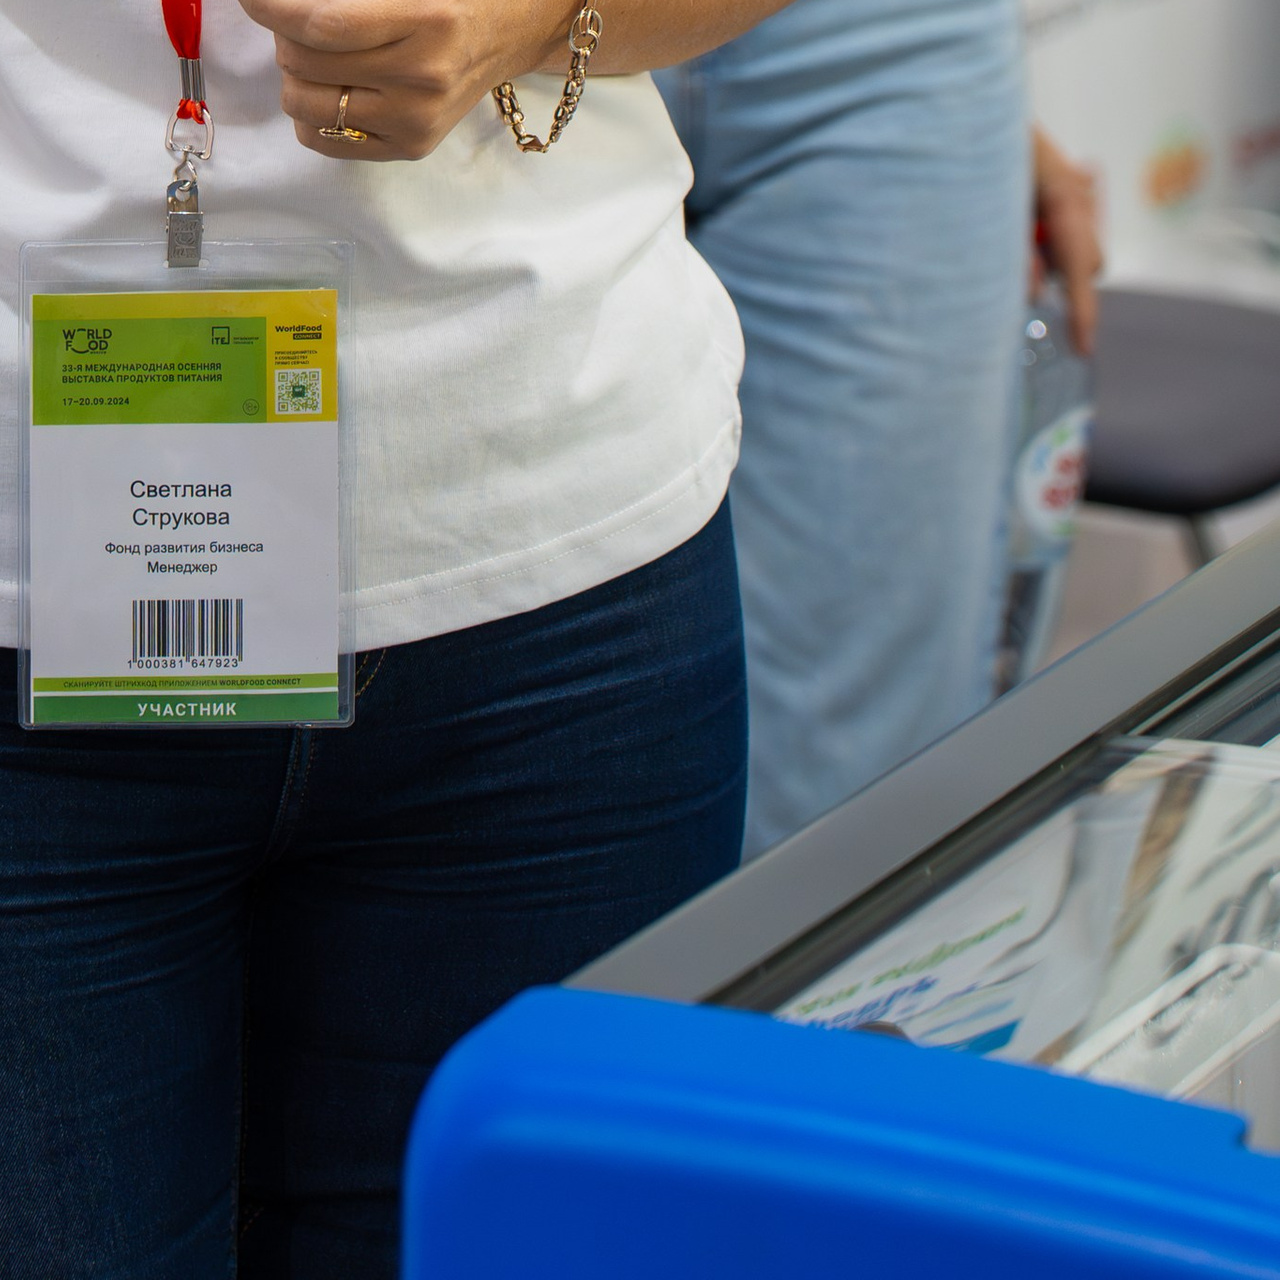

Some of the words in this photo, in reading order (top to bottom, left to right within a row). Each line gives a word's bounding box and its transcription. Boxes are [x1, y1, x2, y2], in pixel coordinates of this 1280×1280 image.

[275, 324, 322, 332] WorldFood
[62, 364, 83, 372] 33-Я
[85, 363, 175, 373] МЕЖДУНАРОДНАЯ
[177, 362, 222, 371] ОСЕННЯЯ
[62, 375, 114, 384] ВЫСТАВКА
[116, 374, 175, 384] ПРОДУКТОВ
[177, 374, 222, 382] ПИТАНИЯ
[130, 480, 233, 498] Светлана
[132, 508, 230, 530] Струкова
[105, 542, 141, 556] Фонд
[144, 543, 206, 556] развития
[209, 541, 264, 554] бизнеса
[147, 561, 218, 575] Менеджер
[63, 680, 113, 689] СКАНИРУЙТЕ
[115, 680, 157, 689] ШТРИХКОД
[158, 679, 218, 688] ПРИЛОЖЕНИЕМ
[219, 679, 265, 687] WORLDFOOD
[266, 678, 301, 686] CONNECT
[137, 702, 237, 717] УЧАСТНИК
